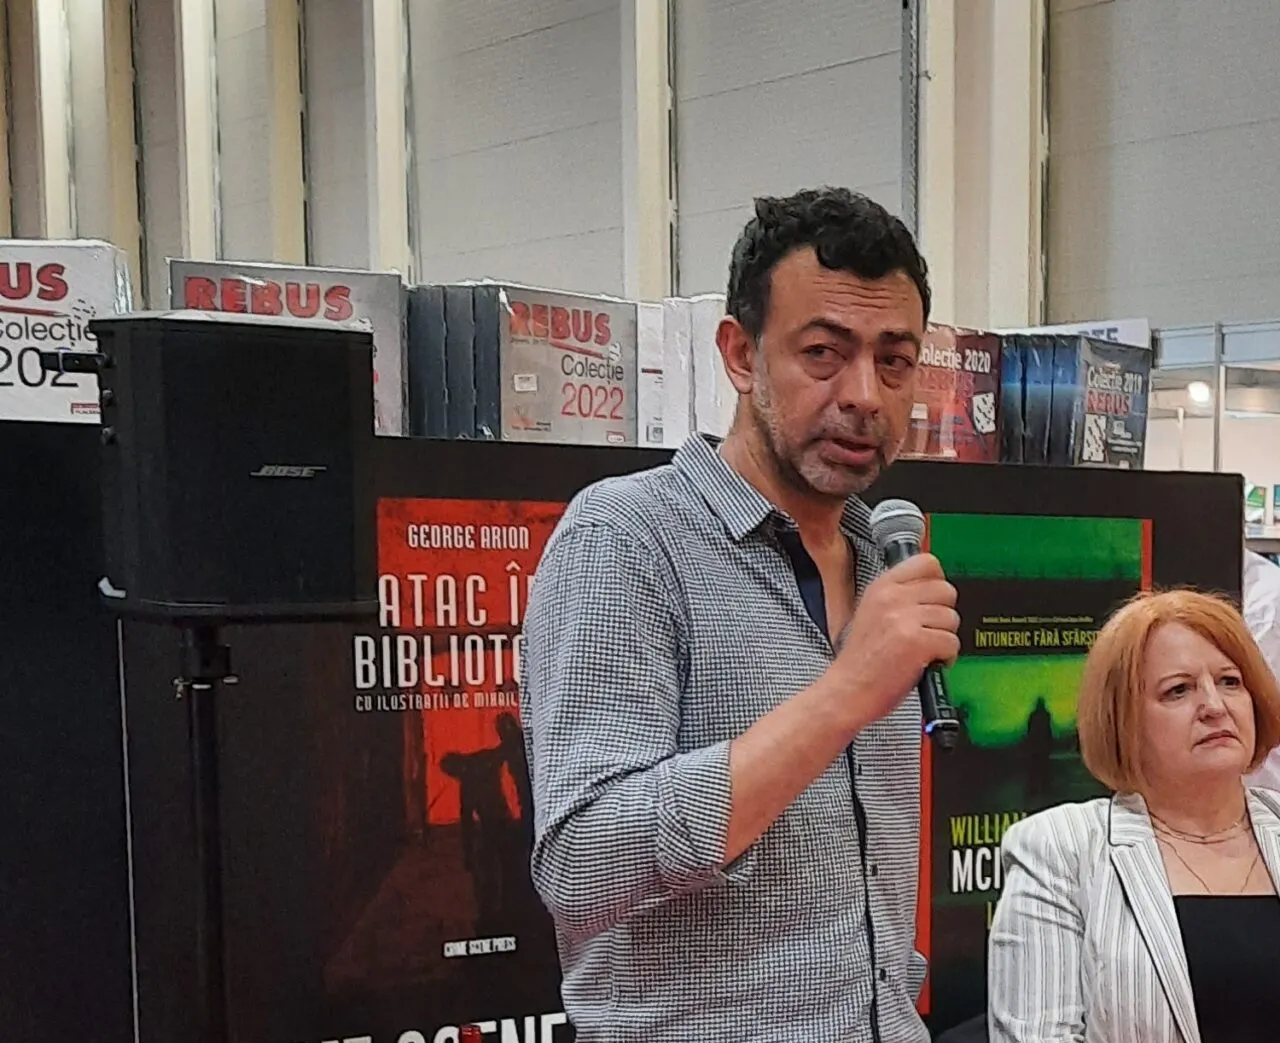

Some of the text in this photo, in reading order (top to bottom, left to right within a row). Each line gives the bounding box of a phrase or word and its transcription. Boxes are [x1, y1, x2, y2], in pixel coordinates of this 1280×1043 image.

[183, 275, 354, 322] REBUS
[509, 300, 612, 346] REBUS
[561, 353, 624, 385] Colecție
[964, 348, 991, 374] 2020
[561, 382, 624, 420] 2022
[407, 523, 530, 550] GEORGE ARION
[378, 560, 536, 628] ATAC Î
[355, 694, 373, 711] CU
